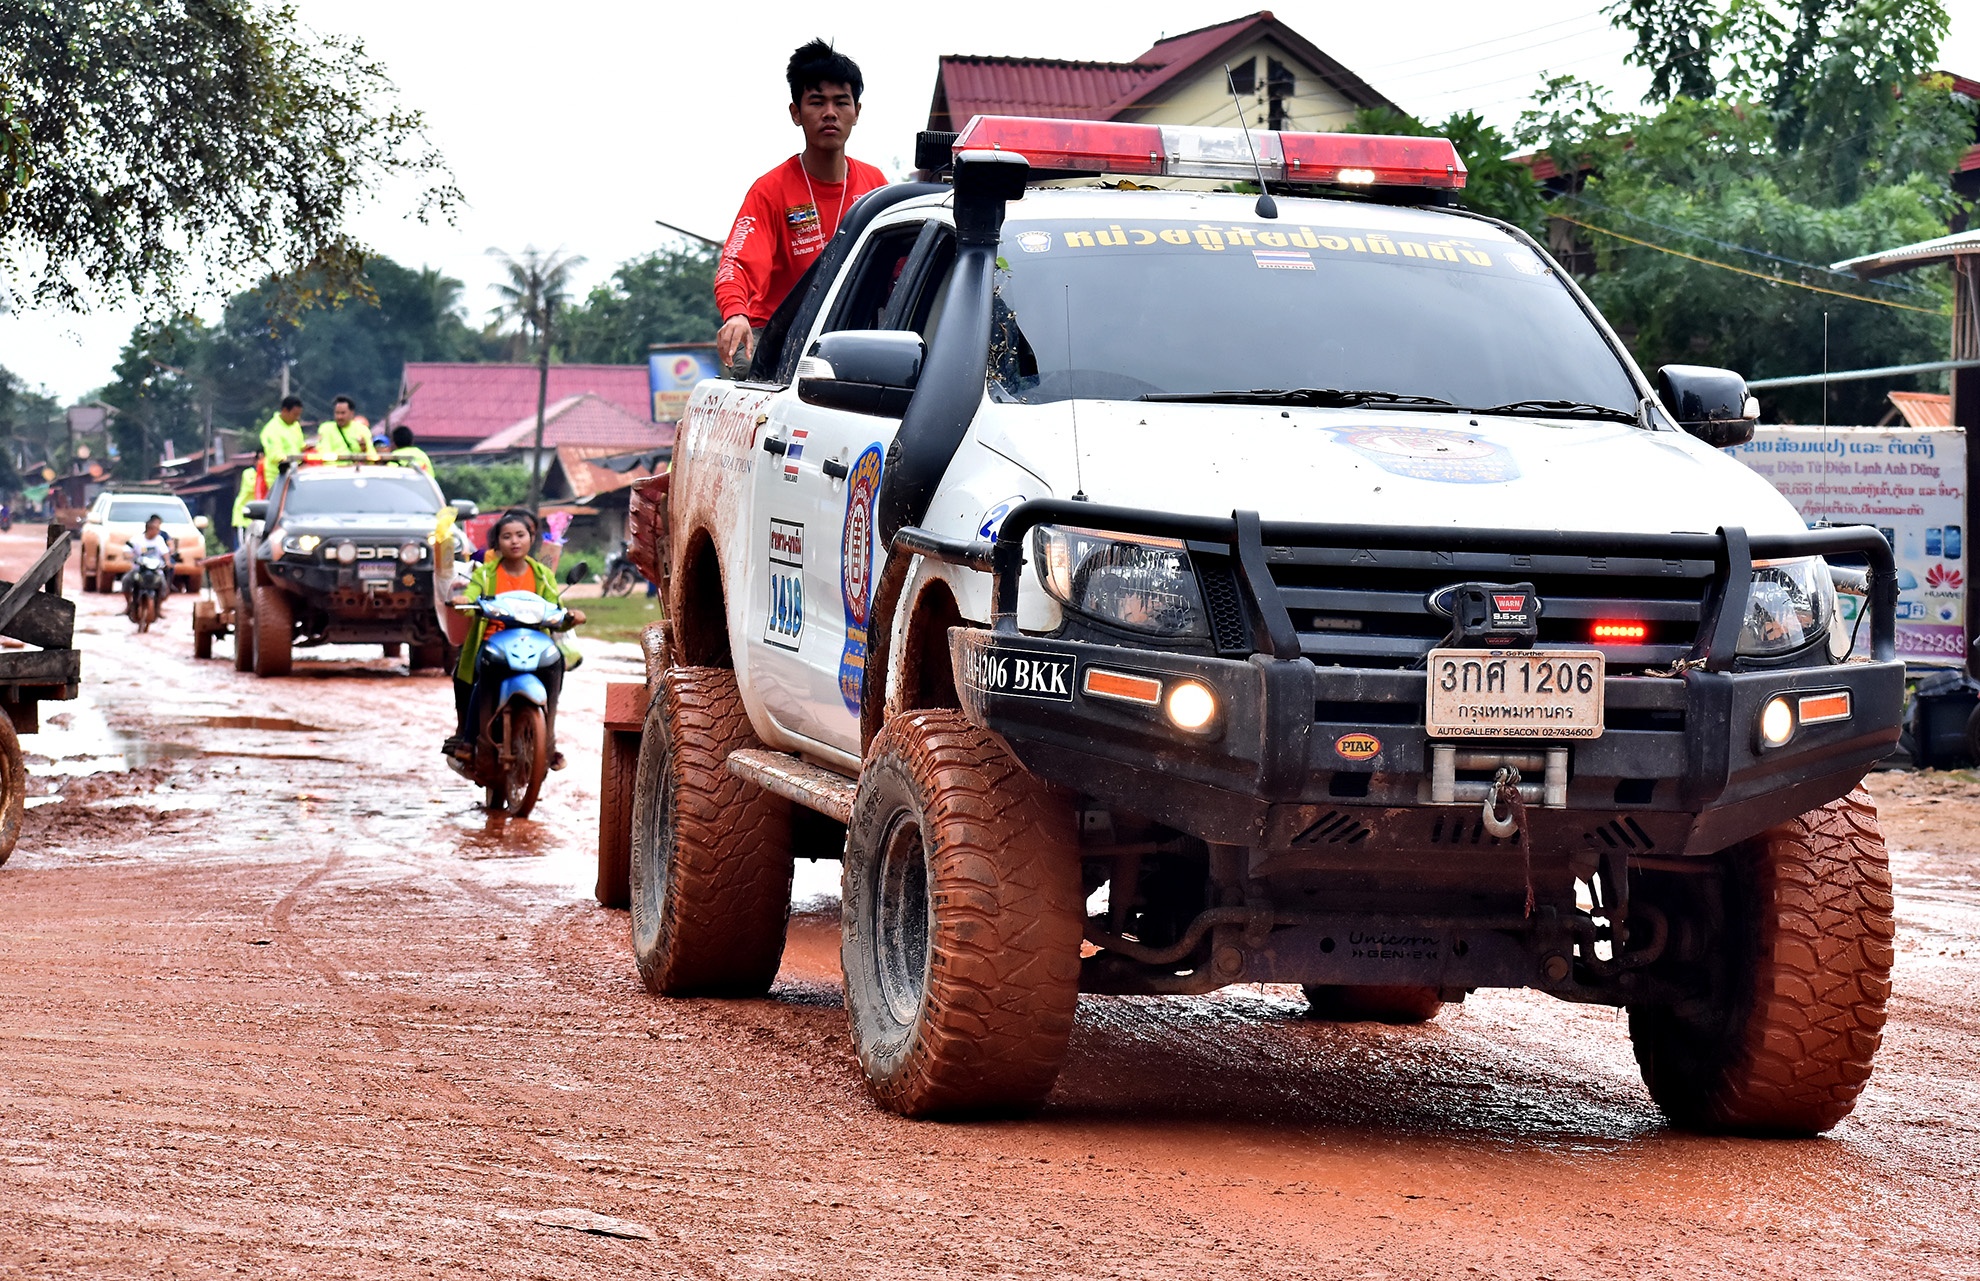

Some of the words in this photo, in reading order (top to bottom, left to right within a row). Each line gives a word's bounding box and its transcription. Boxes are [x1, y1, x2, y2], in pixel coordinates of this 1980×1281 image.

[1885, 462, 1907, 474] Anh
[1270, 546, 1684, 574] RANGER
[769, 573, 803, 638] 1418
[1012, 658, 1070, 695] BKK
[1440, 659, 1507, 693] 3กศ
[1519, 661, 1594, 694] 1206
[1458, 704, 1574, 723] กรุงเทพมหานคร
[1437, 727, 1462, 736] AUTO
[1463, 727, 1501, 736] GALLERY
[1503, 728, 1539, 736] SEACON
[1542, 728, 1593, 737] 02-7434600
[1341, 741, 1375, 752] PIAK
[1349, 931, 1441, 945] Unicorn
